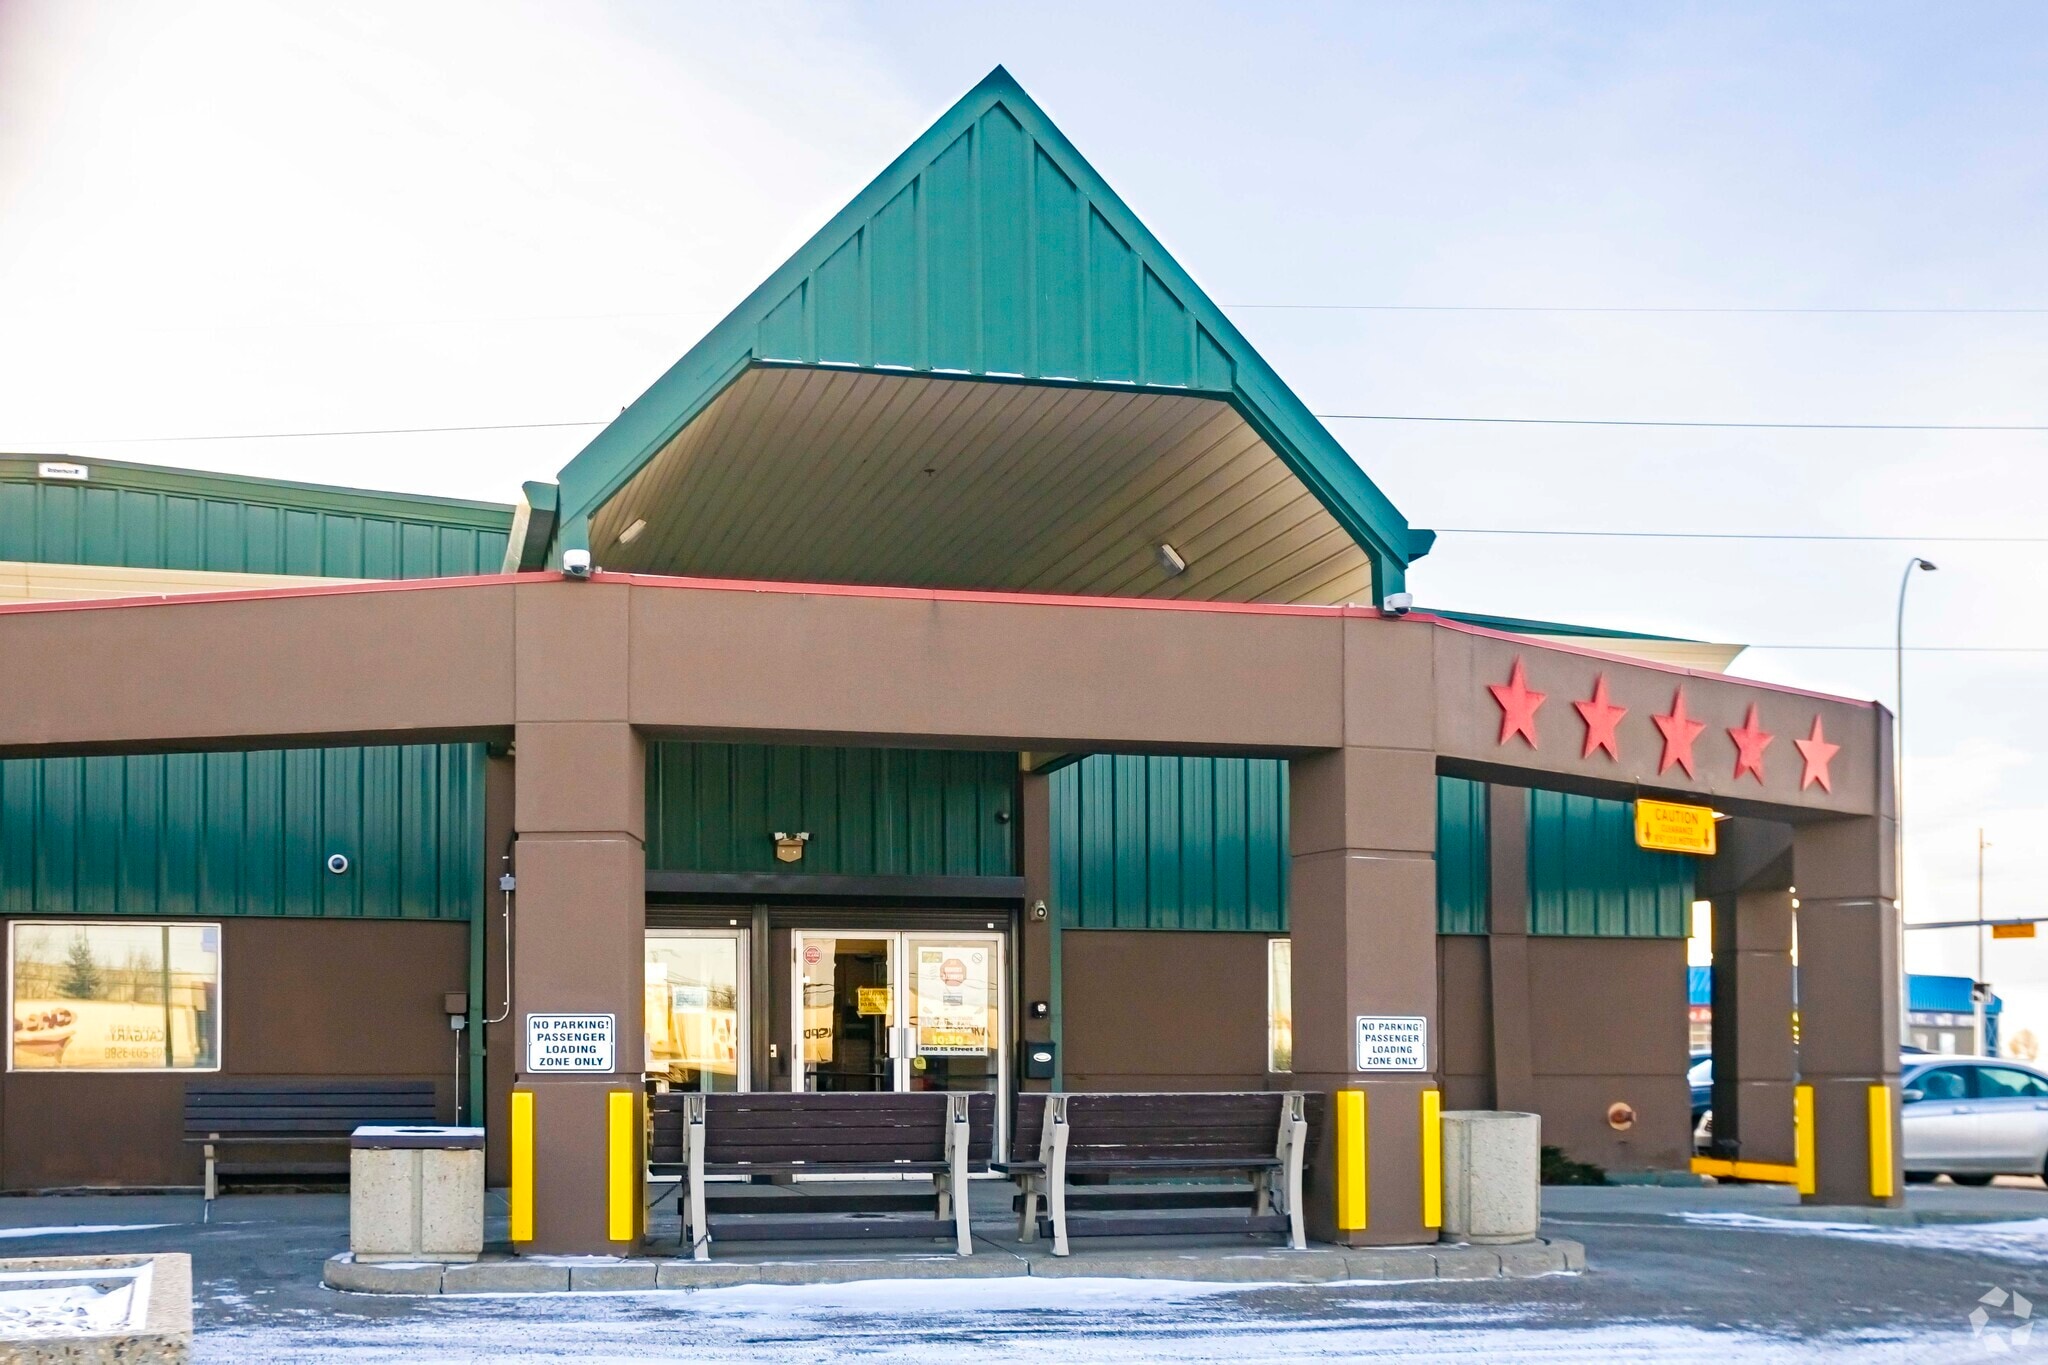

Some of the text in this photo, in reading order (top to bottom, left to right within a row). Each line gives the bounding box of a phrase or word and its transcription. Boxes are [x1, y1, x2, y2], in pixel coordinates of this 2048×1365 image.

[1655, 808, 1698, 825] CAUTION
[533, 1021, 609, 1029] NO PARKING!
[1362, 1023, 1422, 1031] NO PARKING!
[537, 1033, 606, 1041] PASSENGER
[1365, 1034, 1420, 1042] PASSENGER
[546, 1045, 597, 1053] LOADING
[1372, 1045, 1413, 1054] LOADING
[539, 1057, 604, 1066] ZONE ONLY
[1367, 1057, 1418, 1065] ZONE ONLY
